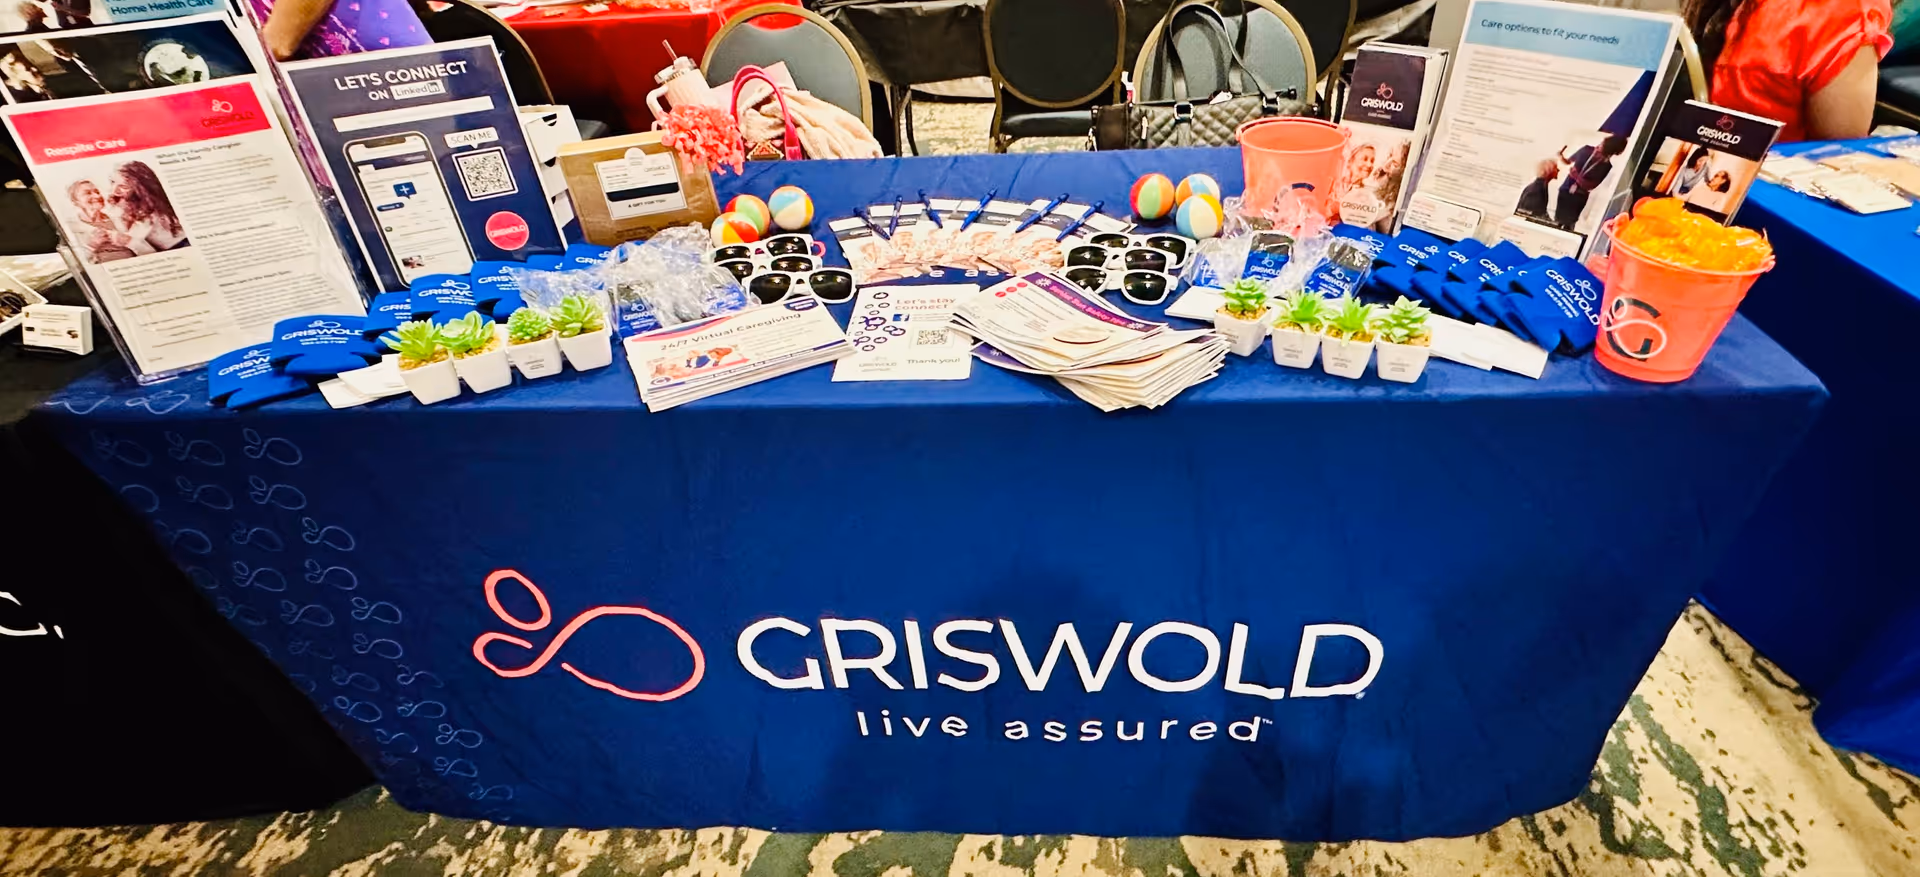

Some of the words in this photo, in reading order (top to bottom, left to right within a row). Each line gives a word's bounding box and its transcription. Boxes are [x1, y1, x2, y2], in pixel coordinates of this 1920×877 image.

[111, 5, 147, 14] Home
[149, 1, 186, 11] Health
[1481, 19, 1503, 29] Care
[1504, 23, 1540, 34] options
[1565, 32, 1588, 40] your
[1590, 35, 1620, 44] needs
[334, 73, 383, 91] LET'S
[384, 61, 467, 84] CONNECT
[368, 90, 390, 101] ON
[1361, 97, 1404, 112] GRISWOLD
[450, 134, 477, 145] SCAN
[477, 131, 492, 139] ME
[1696, 125, 1742, 145] GRISWOLD
[44, 143, 95, 157] Respite
[95, 139, 127, 149] Care
[1341, 201, 1378, 214] GRISWOLD
[929, 297, 957, 305] stay
[1545, 269, 1601, 326] GRISWOLD
[691, 328, 734, 343] Virtual
[736, 313, 802, 333] Caregiving
[217, 356, 271, 376] GRISW
[736, 616, 1384, 700] GRISWOLD
[856, 710, 968, 738] live
